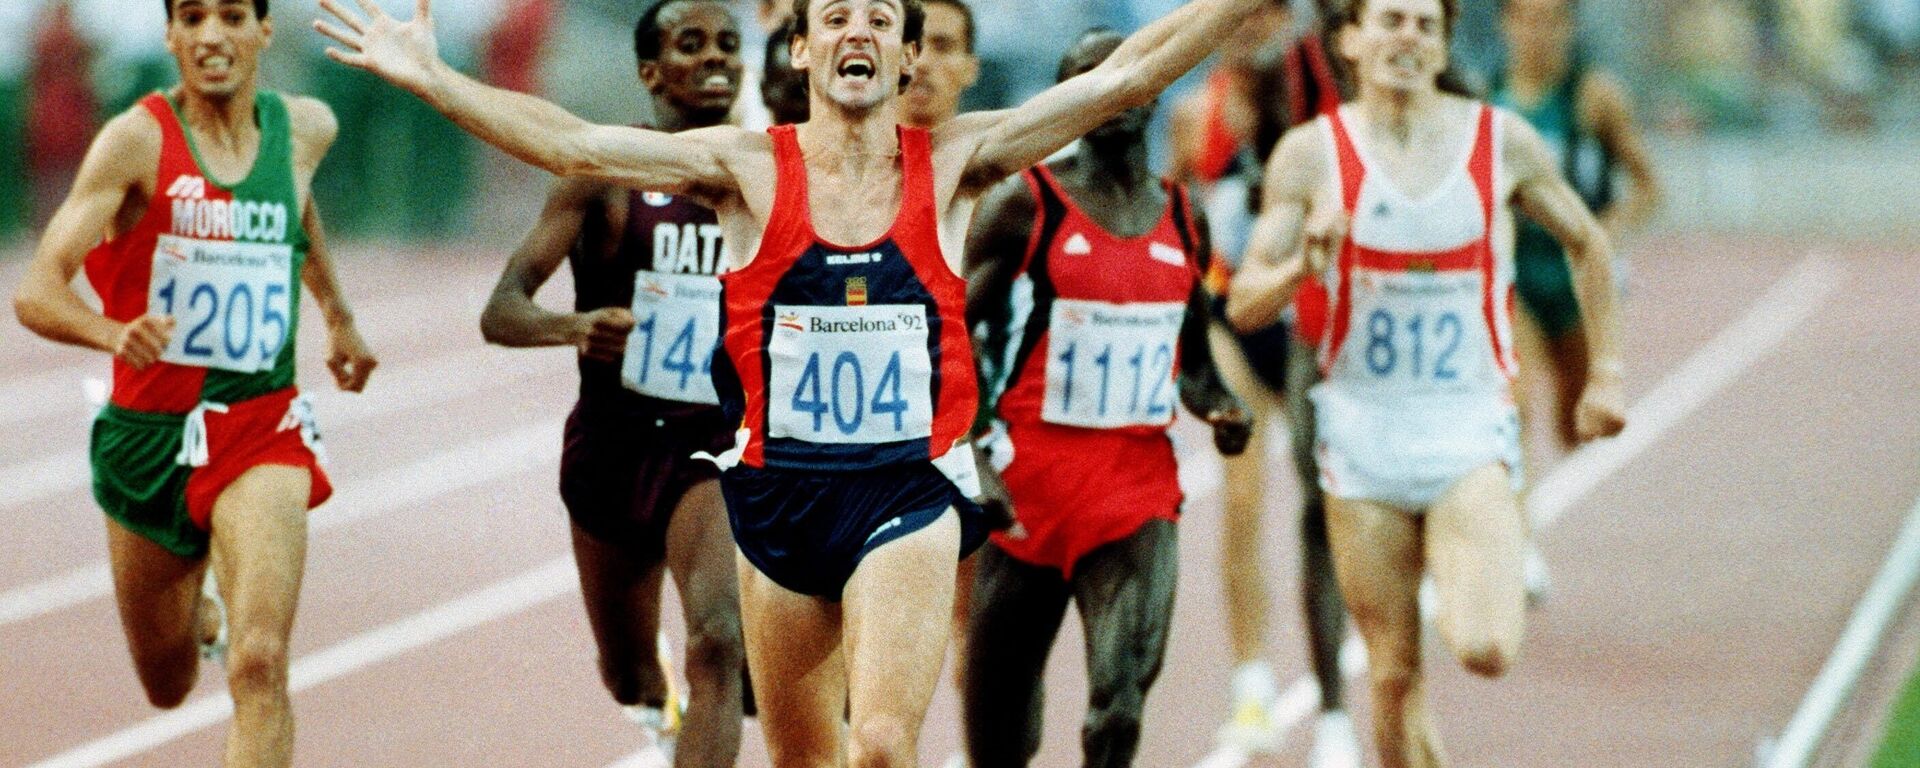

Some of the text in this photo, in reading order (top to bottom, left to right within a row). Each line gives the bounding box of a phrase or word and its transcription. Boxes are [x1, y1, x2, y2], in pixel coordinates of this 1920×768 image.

[172, 199, 287, 241] MOROCCO
[810, 313, 922, 333] Barcelona '92
[1366, 309, 1462, 379] 812
[792, 351, 908, 436] 404
[1059, 342, 1170, 416] 1112
